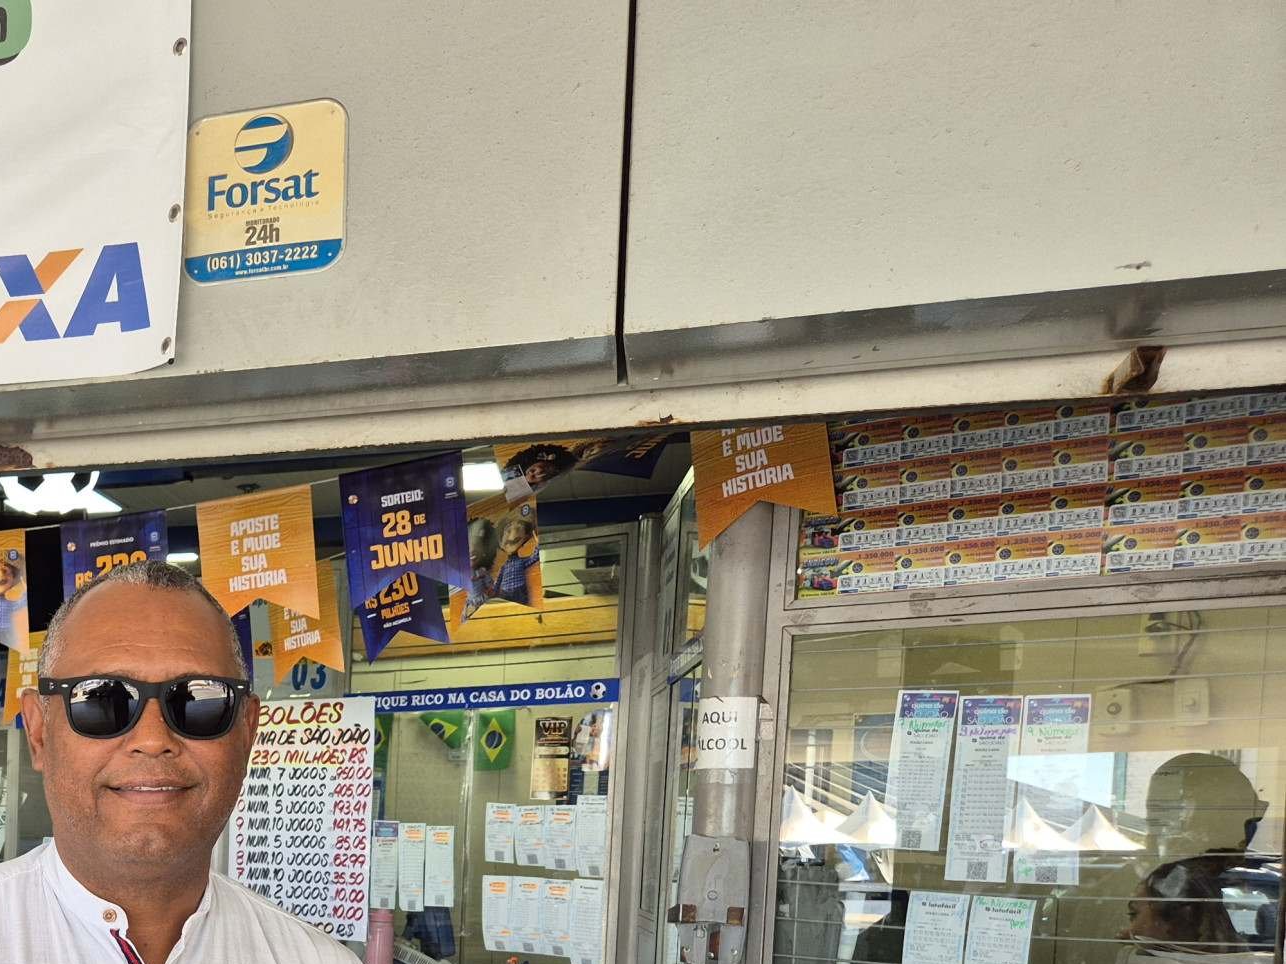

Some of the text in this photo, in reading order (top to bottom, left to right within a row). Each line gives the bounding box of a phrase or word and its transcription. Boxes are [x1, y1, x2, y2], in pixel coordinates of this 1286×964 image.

[207, 169, 320, 212] Forsat
[245, 224, 280, 247] 24h
[207, 244, 318, 273] (061) 3037-2222
[722, 425, 784, 457] E MUDE
[735, 448, 768, 473] SUA
[722, 463, 795, 498] HISTÓRIA
[380, 489, 424, 508] SORTEIO:
[230, 514, 279, 536] APOSTE
[381, 509, 413, 538] 28
[231, 533, 281, 556] E MUDE
[370, 534, 444, 570] JUNHO
[241, 553, 268, 572] SUA
[229, 569, 288, 593] HISTÓRIA
[290, 618, 308, 634] SUA
[284, 630, 321, 651] HISTÓRIA
[411, 683, 586, 706] RICO NA CASA DO BOLÃO
[258, 701, 344, 727] BOLÕES
[702, 712, 737, 725] AQUI
[300, 723, 371, 746] SÃO JOÃO
[541, 720, 567, 736] VIP
[251, 745, 346, 765] 230 MILHÕES
[277, 767, 286, 781] 7
[275, 799, 283, 814] 5
[274, 884, 283, 899] 2
